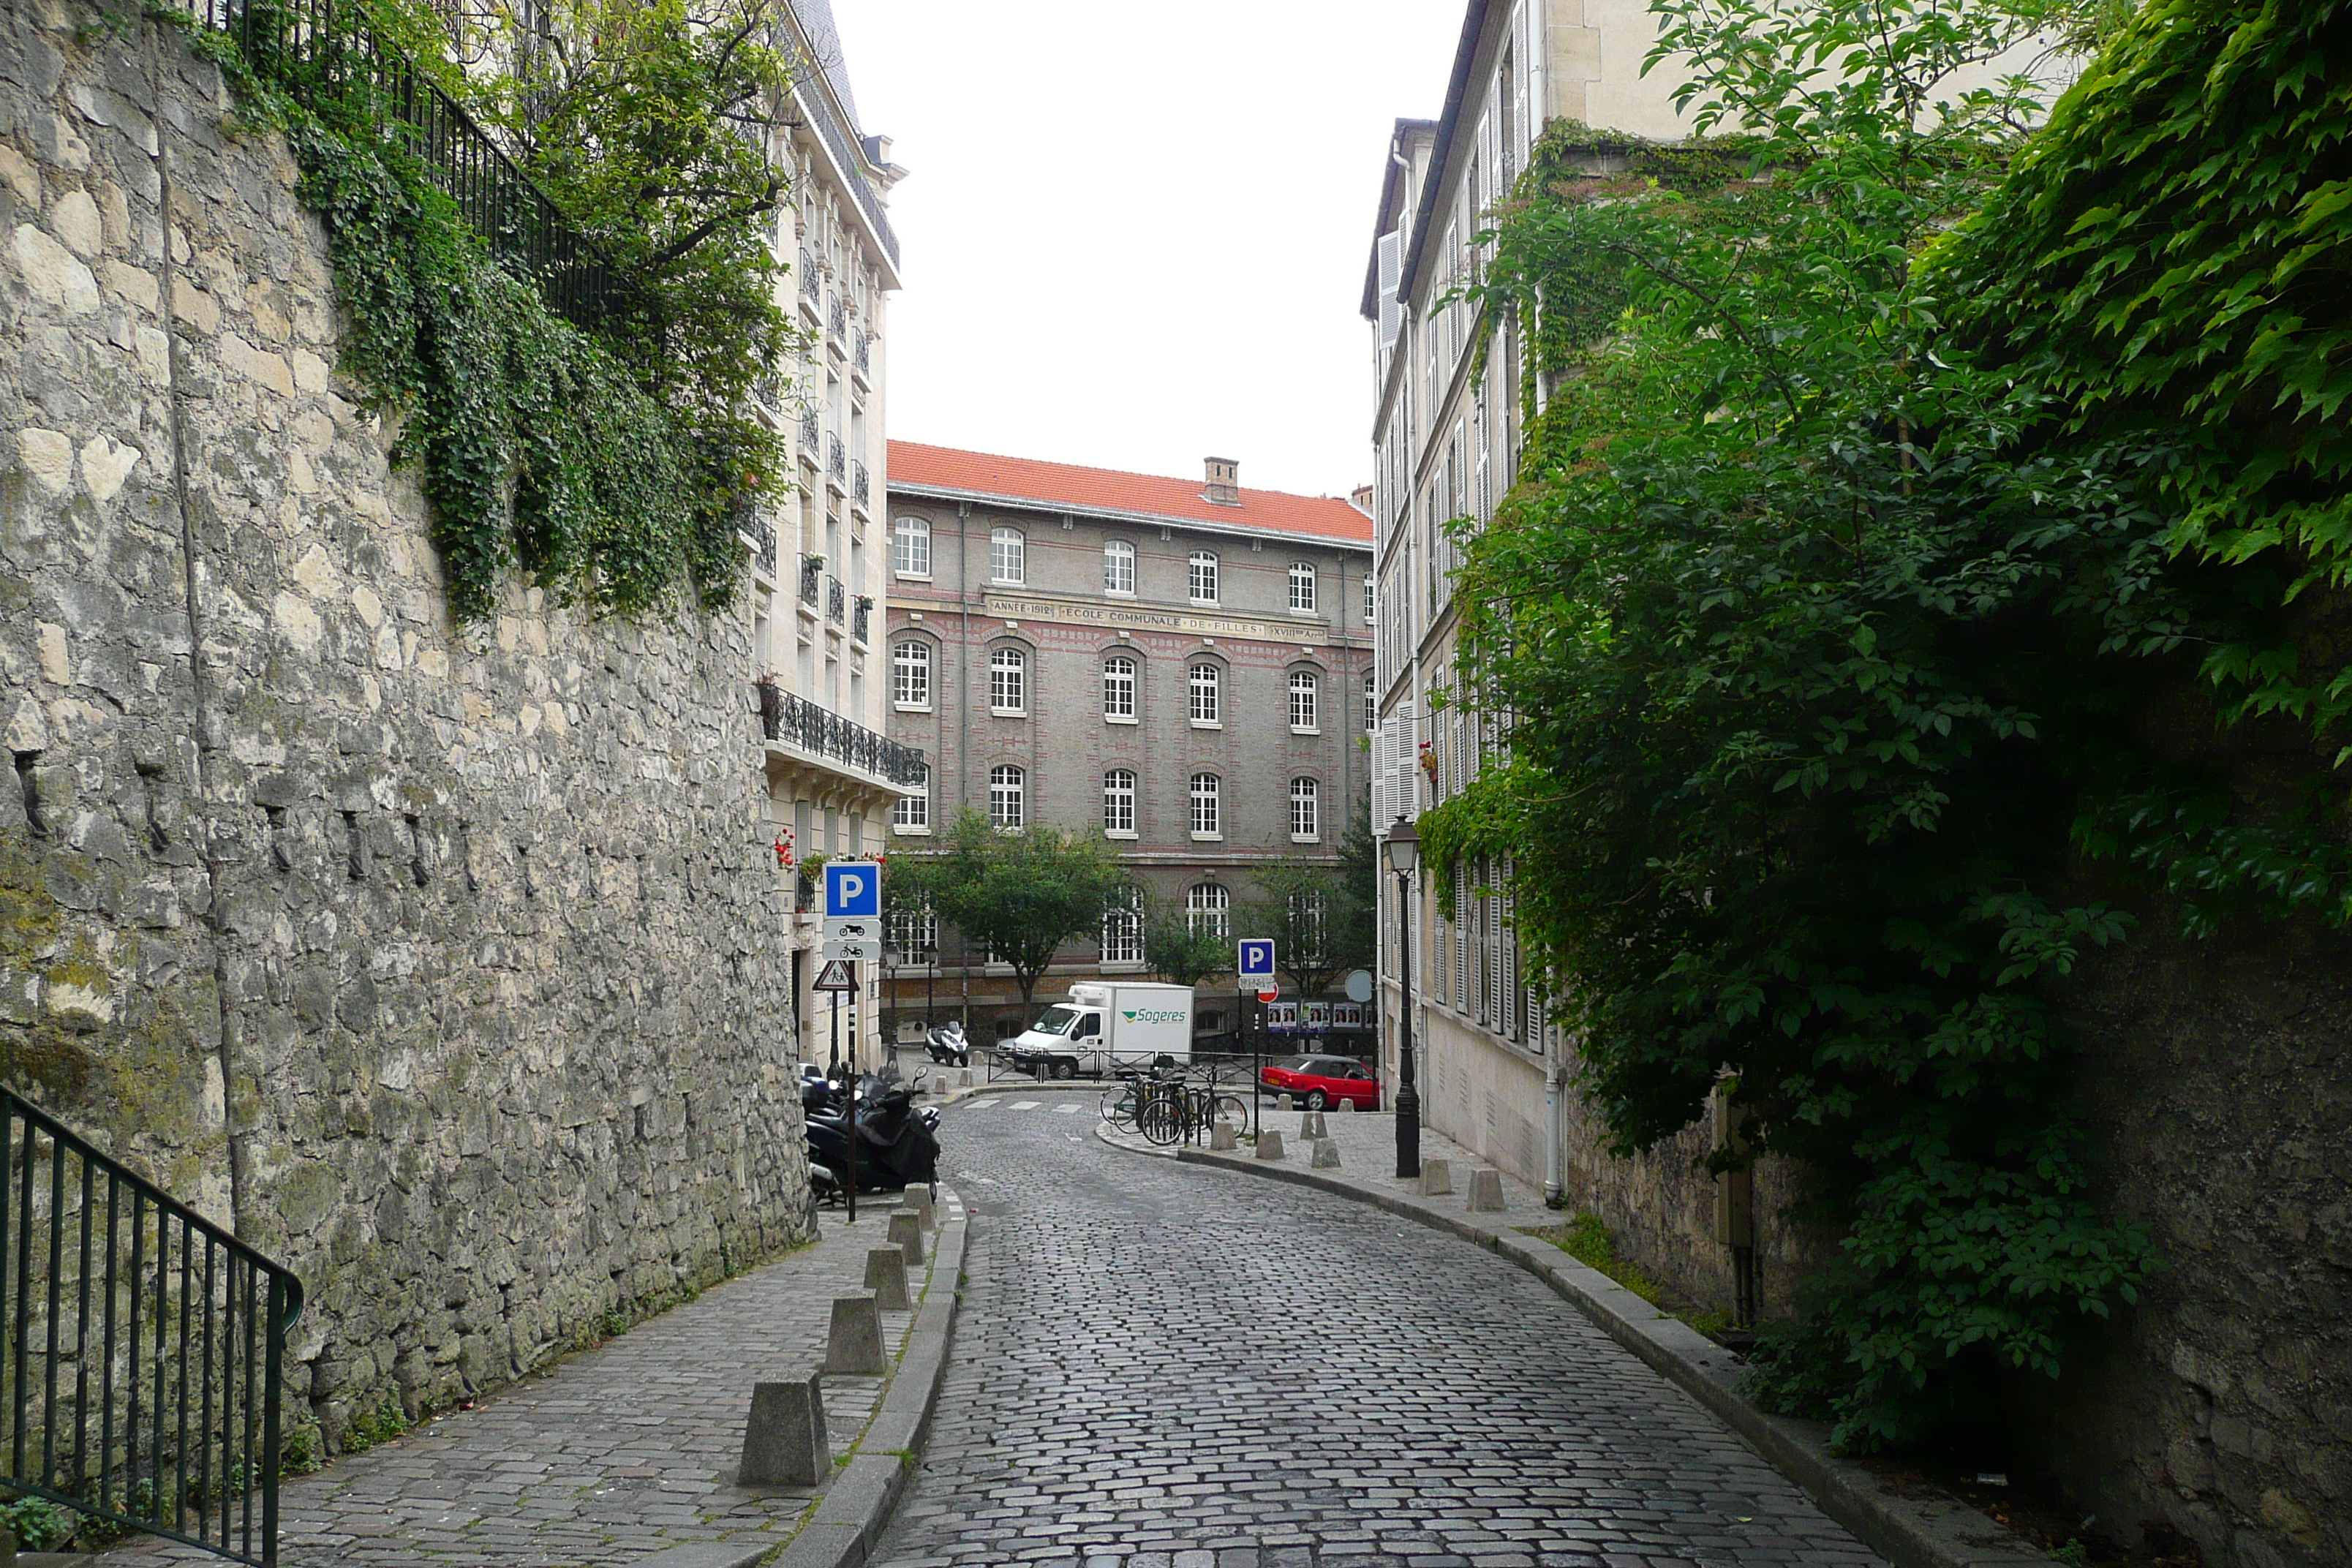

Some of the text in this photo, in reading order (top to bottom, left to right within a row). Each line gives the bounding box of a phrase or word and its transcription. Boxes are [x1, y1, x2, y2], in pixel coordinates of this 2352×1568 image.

[1031, 605, 1049, 614] 1912
[1109, 612, 1181, 627] COMMUNALE
[1190, 619, 1206, 629] DE
[1214, 622, 1257, 633] FILLES
[840, 874, 864, 908] P
[1248, 946, 1264, 969] P
[1137, 1008, 1186, 1025] Sogeres
